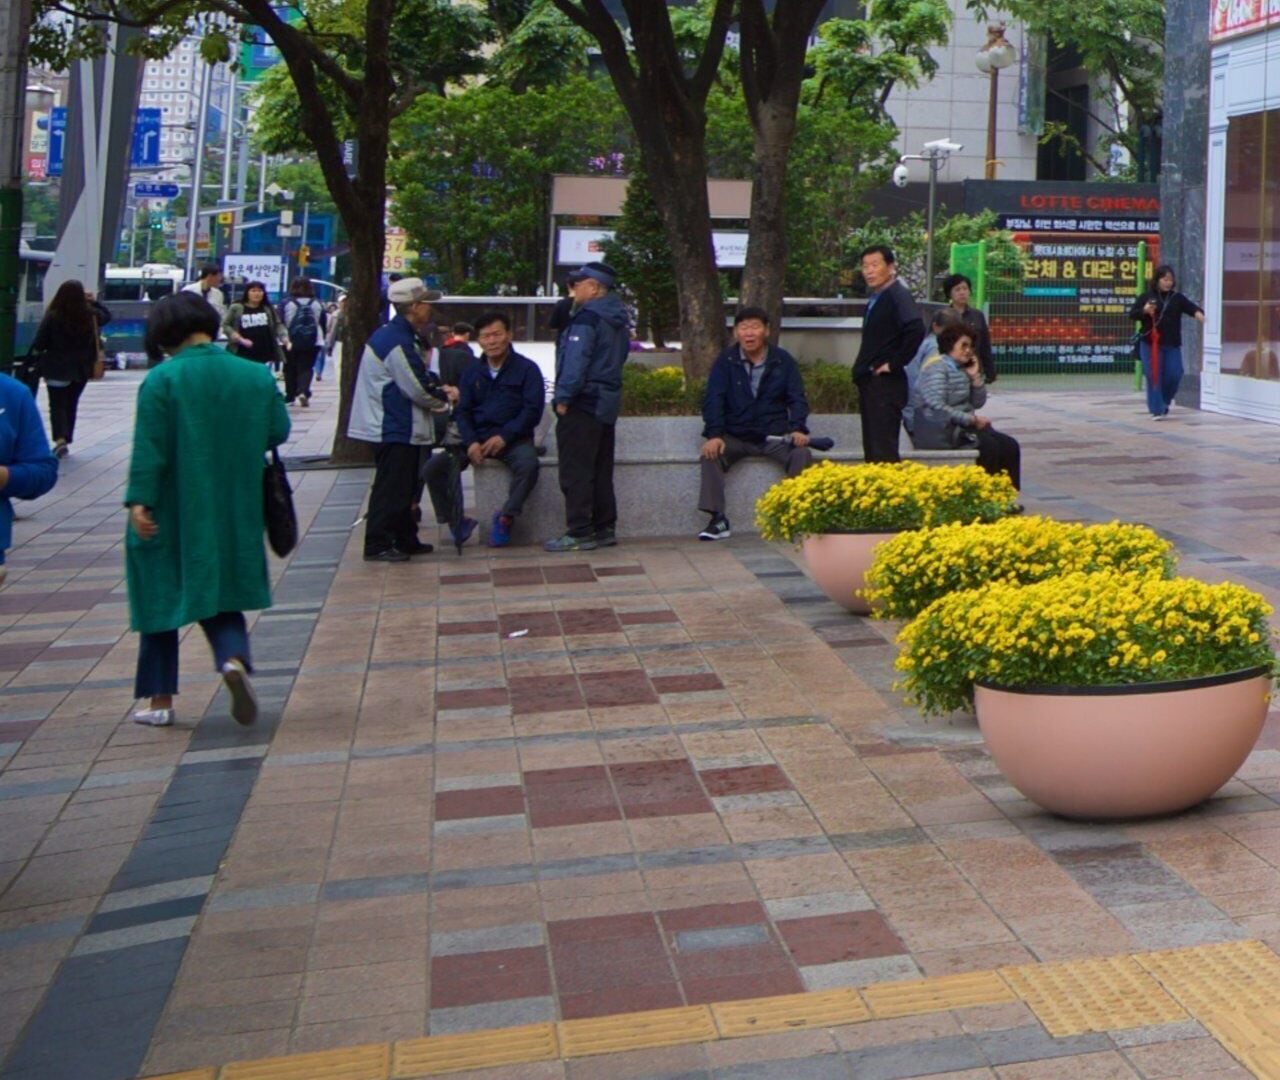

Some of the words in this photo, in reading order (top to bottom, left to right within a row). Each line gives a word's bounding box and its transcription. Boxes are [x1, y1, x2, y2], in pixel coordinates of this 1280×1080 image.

[1020, 195, 1081, 210] LOTTE
[1087, 196, 1160, 211] CINEMA
[1024, 259, 1057, 279] 단체
[1062, 261, 1077, 279] &
[1082, 260, 1116, 279] 대관
